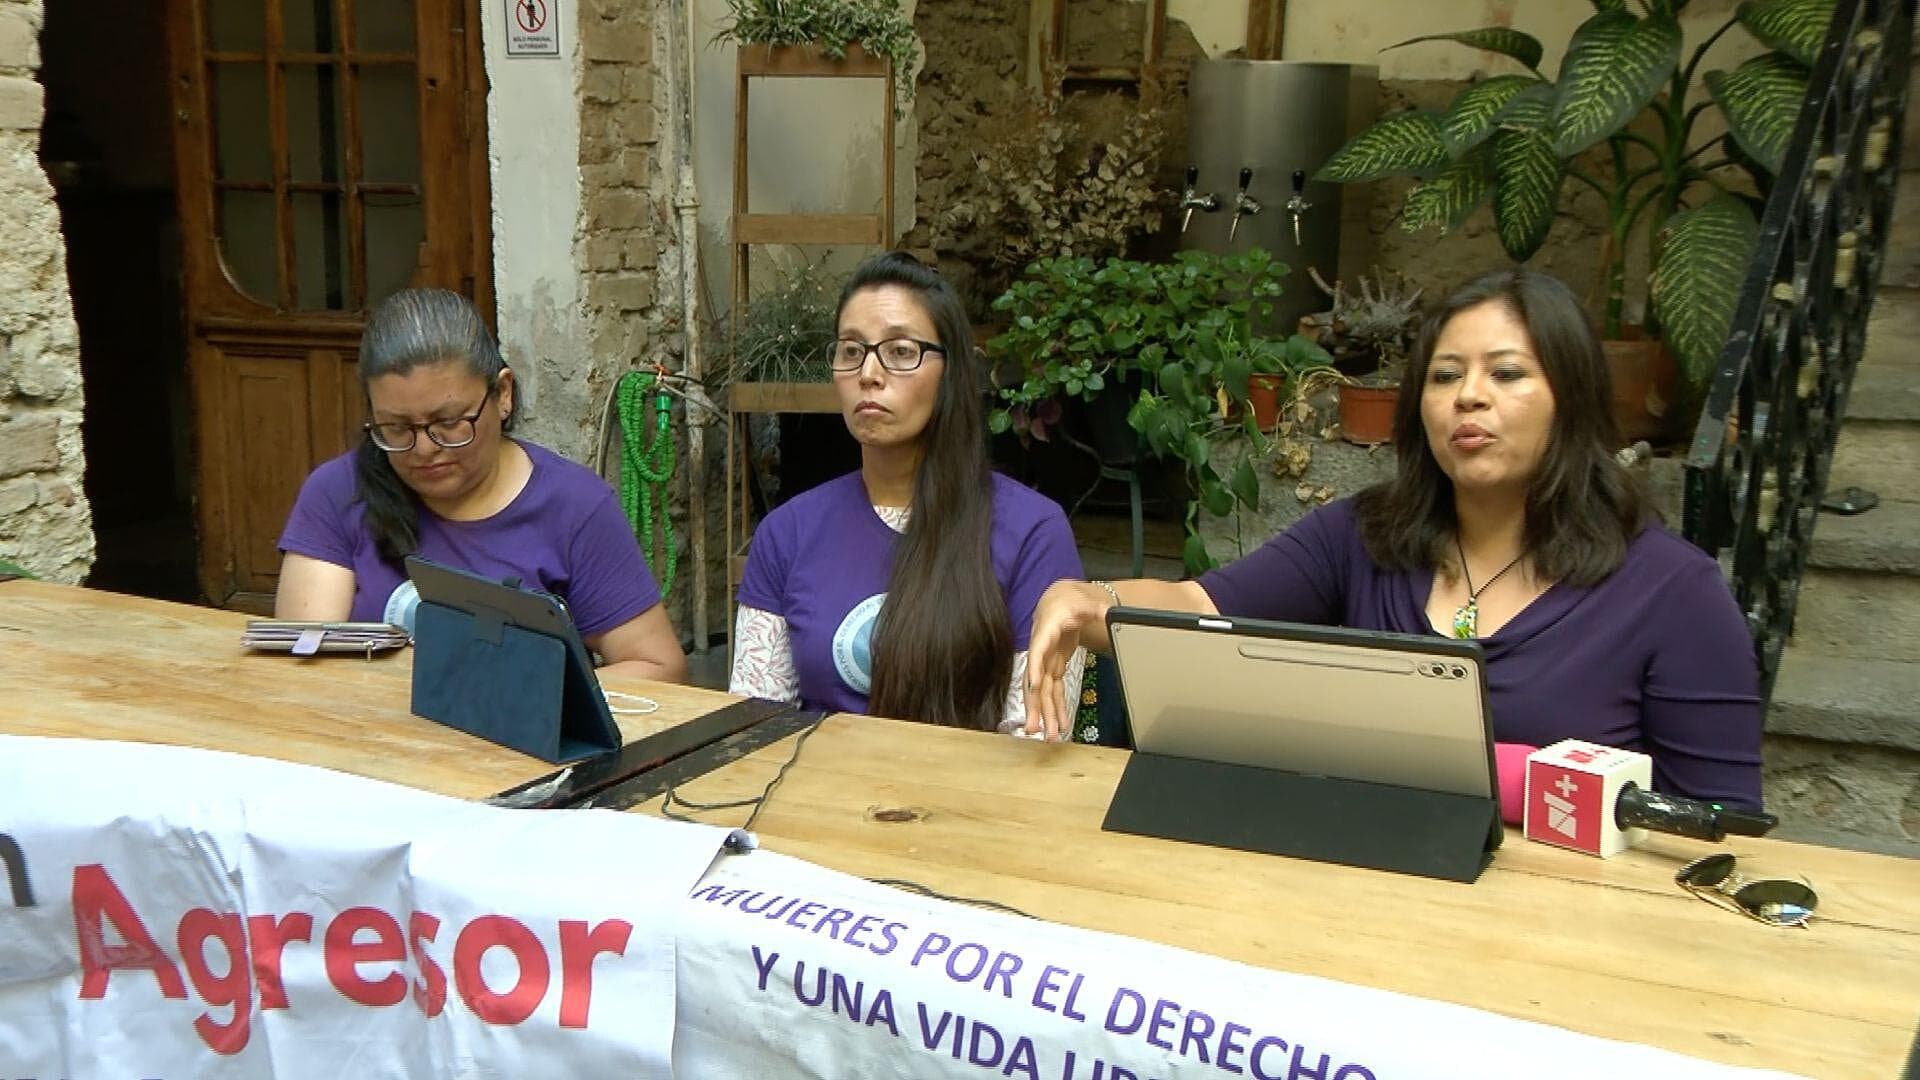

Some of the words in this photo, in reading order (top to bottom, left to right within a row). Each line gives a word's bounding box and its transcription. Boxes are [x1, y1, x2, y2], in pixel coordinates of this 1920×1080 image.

[72, 863, 634, 1055] Agresor
[691, 885, 909, 955] MUJERES
[911, 932, 1023, 998] POR
[1032, 965, 1085, 1022] EL
[751, 945, 779, 990] Y
[794, 961, 899, 1037] UNA
[917, 1002, 1040, 1080] VIDA
